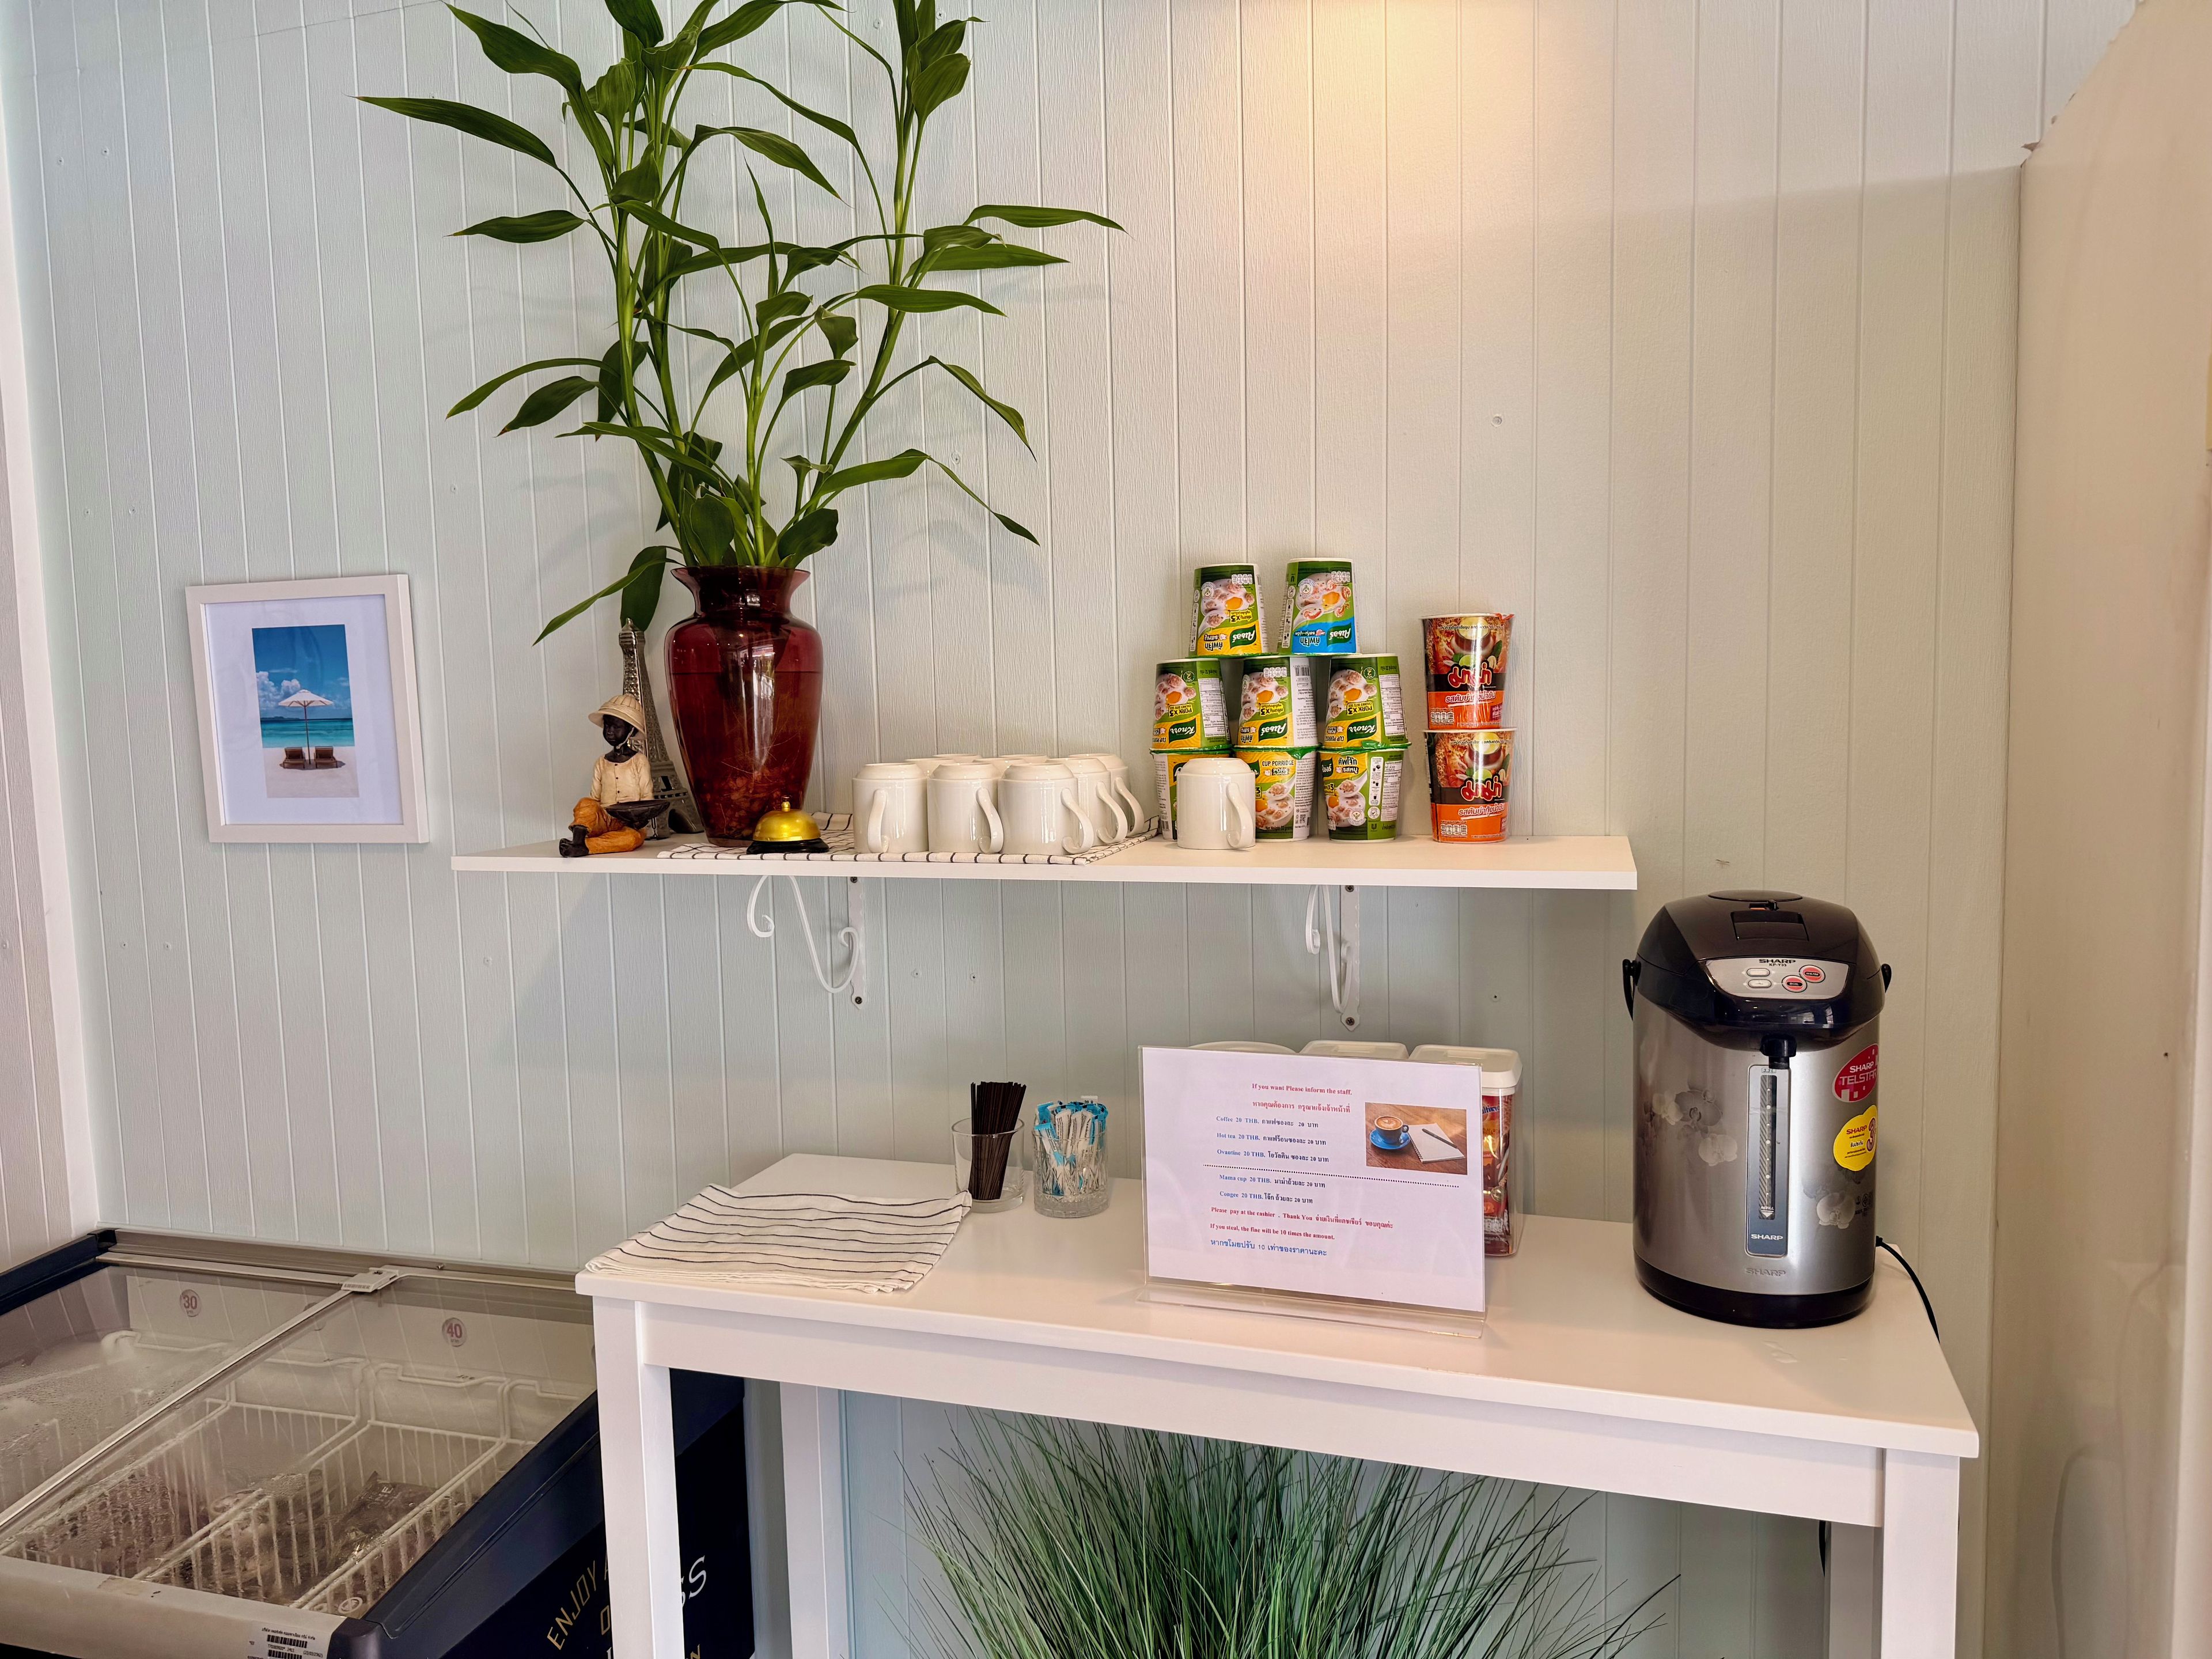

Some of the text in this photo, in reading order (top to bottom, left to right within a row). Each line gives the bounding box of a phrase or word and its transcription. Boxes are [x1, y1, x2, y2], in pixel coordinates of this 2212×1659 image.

[1205, 642, 1223, 651] คัพโจ๊ก
[1170, 726, 1195, 734] Knorr
[1348, 724, 1376, 733] Knorr
[1338, 756, 1357, 765] คัพโจ๊ก
[1460, 776, 1502, 801] มาม่า
[1850, 1061, 1874, 1073] SHARP
[1840, 1068, 1877, 1086] TELSTAR
[1252, 1100, 1350, 1113] หากคุณต้องการ กรุณาแจ้งเจ้าหน้าที่
[1846, 1125, 1867, 1135] SHARP
[1264, 1192, 1274, 1200] โจ๊ก
[1211, 1238, 1255, 1249] หากขโมยปรับ
[1267, 1244, 1327, 1256] เท่าของราคานะคะ
[1746, 1268, 1786, 1277] SHARP
[183, 1296, 197, 1310] 30
[446, 1323, 463, 1339] 40
[547, 1560, 596, 1650] ENJOY
